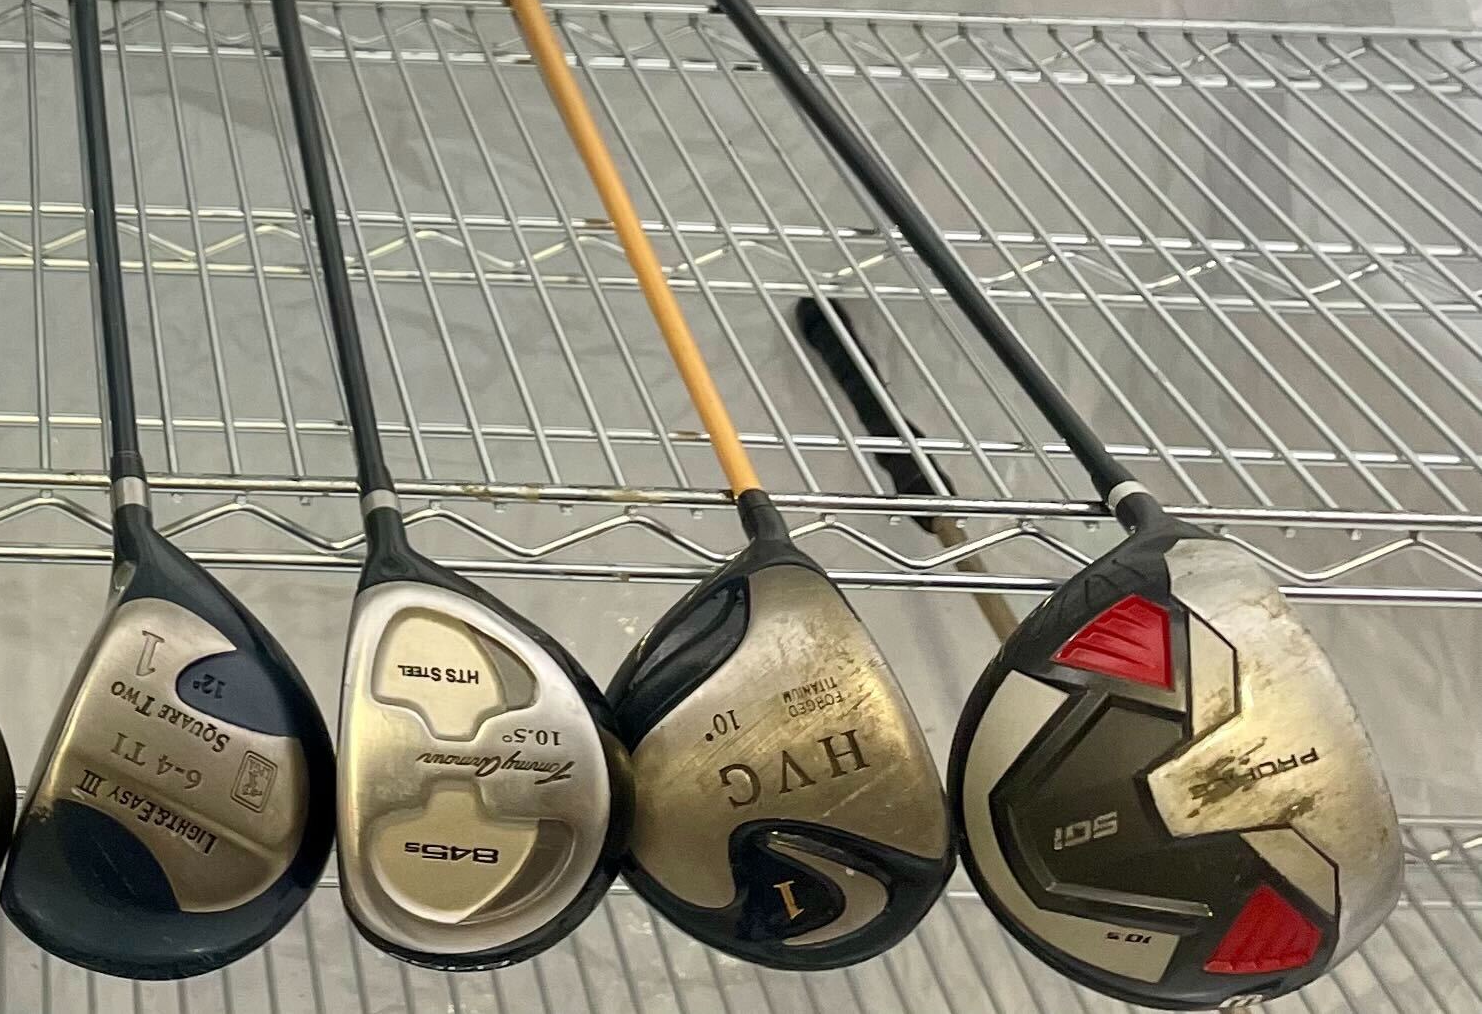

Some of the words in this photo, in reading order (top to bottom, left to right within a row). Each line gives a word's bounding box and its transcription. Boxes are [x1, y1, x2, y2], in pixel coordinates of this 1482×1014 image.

[136, 629, 166, 678] 1
[397, 664, 443, 683] STEEL
[446, 668, 480, 686] HTS
[782, 676, 839, 704] TITANIUM
[788, 691, 844, 719] FORGED
[500, 750, 577, 786] Tommy
[76, 768, 109, 798] III
